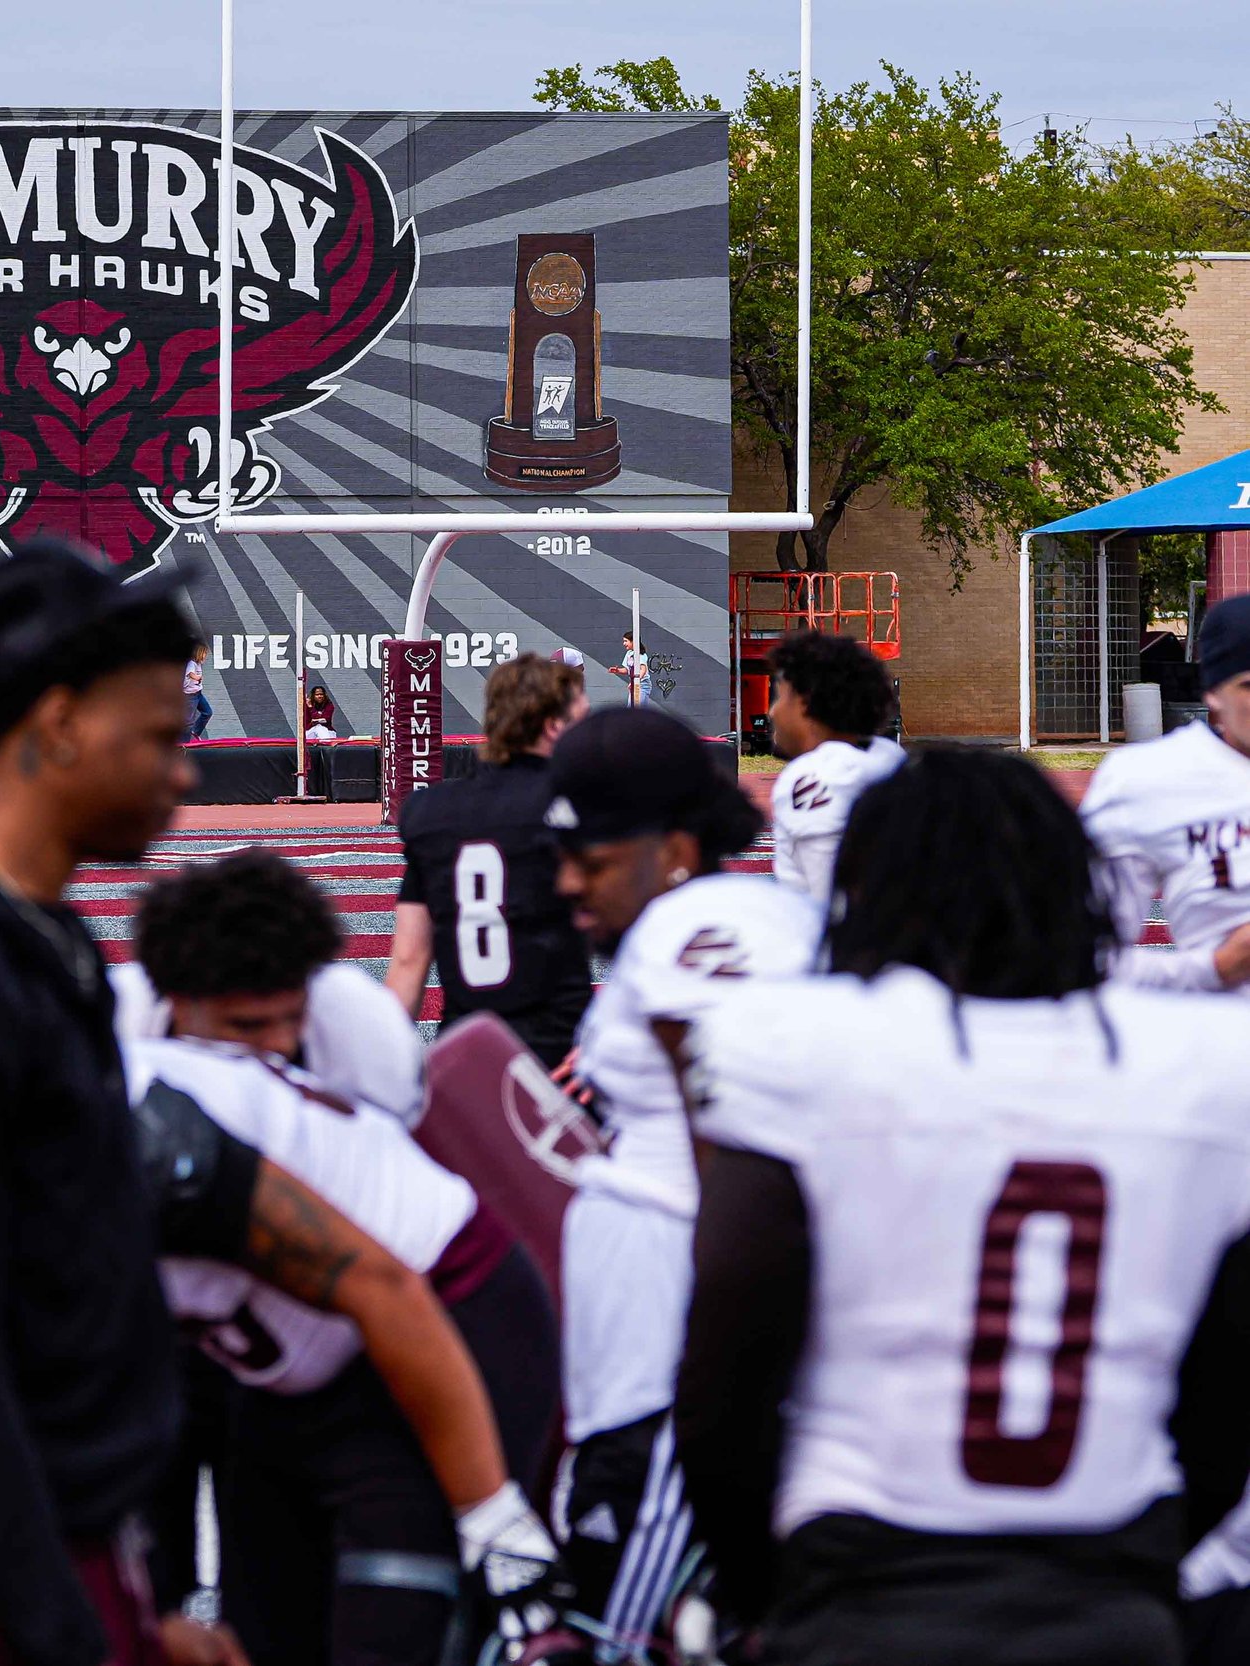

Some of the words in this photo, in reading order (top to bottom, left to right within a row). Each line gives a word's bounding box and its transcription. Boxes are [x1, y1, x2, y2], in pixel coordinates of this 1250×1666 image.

[522, 468, 552, 477] NATIONAL
[552, 468, 586, 477] CHAMPION
[184, 532, 206, 544] TM
[213, 634, 290, 670] LIFE
[382, 647, 390, 821] RESPONSIBILITY
[389, 679, 397, 790] INTEGRITY
[454, 842, 512, 988] 8
[960, 1160, 1109, 1490] 0
